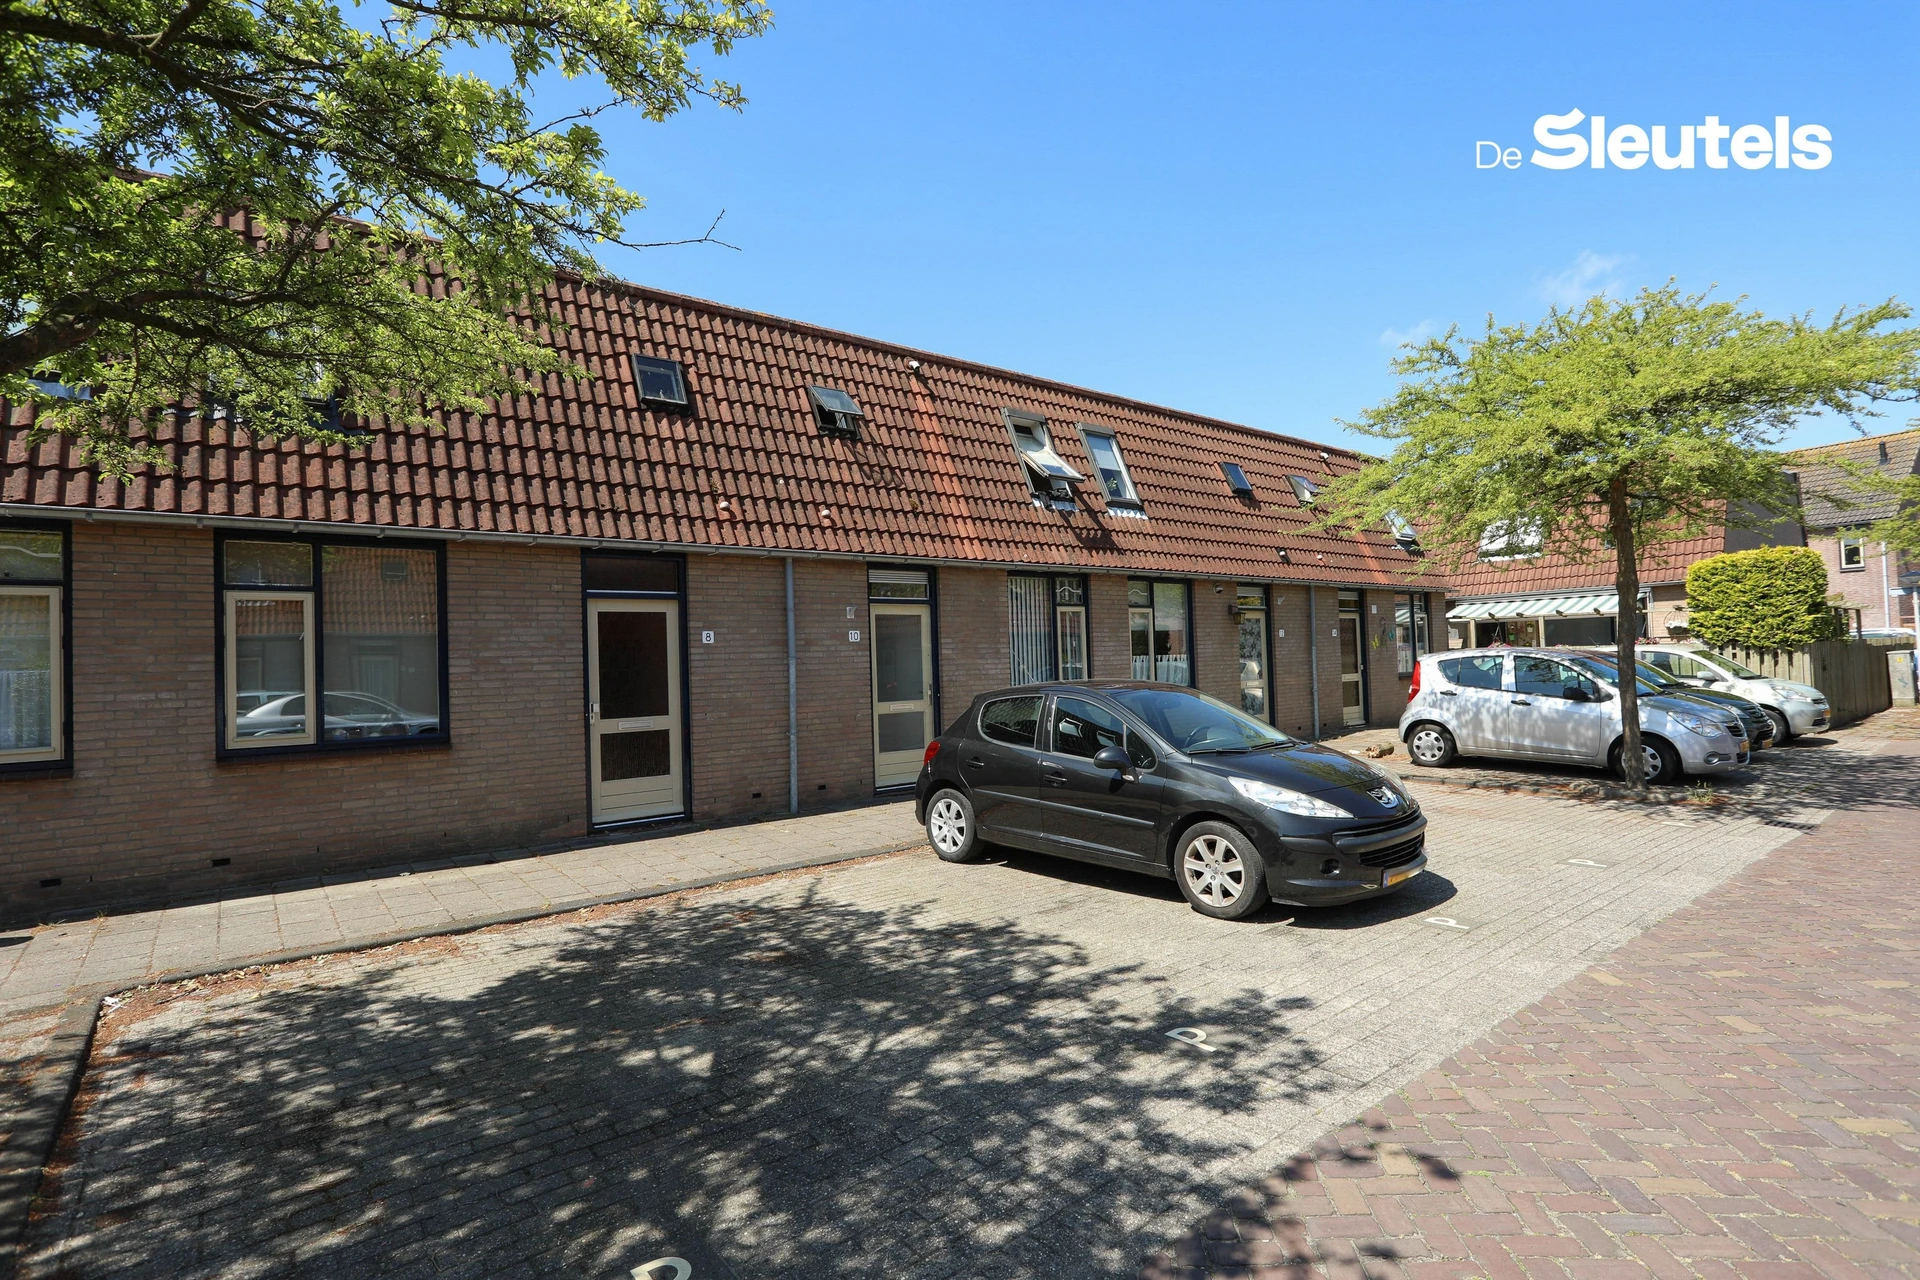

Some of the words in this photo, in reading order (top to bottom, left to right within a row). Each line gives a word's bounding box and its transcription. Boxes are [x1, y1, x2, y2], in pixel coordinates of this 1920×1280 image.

[705, 632, 712, 642] 8
[849, 631, 859, 641] 10
[1567, 858, 1608, 868] P
[1423, 916, 1470, 930] P
[1164, 1027, 1218, 1053] P
